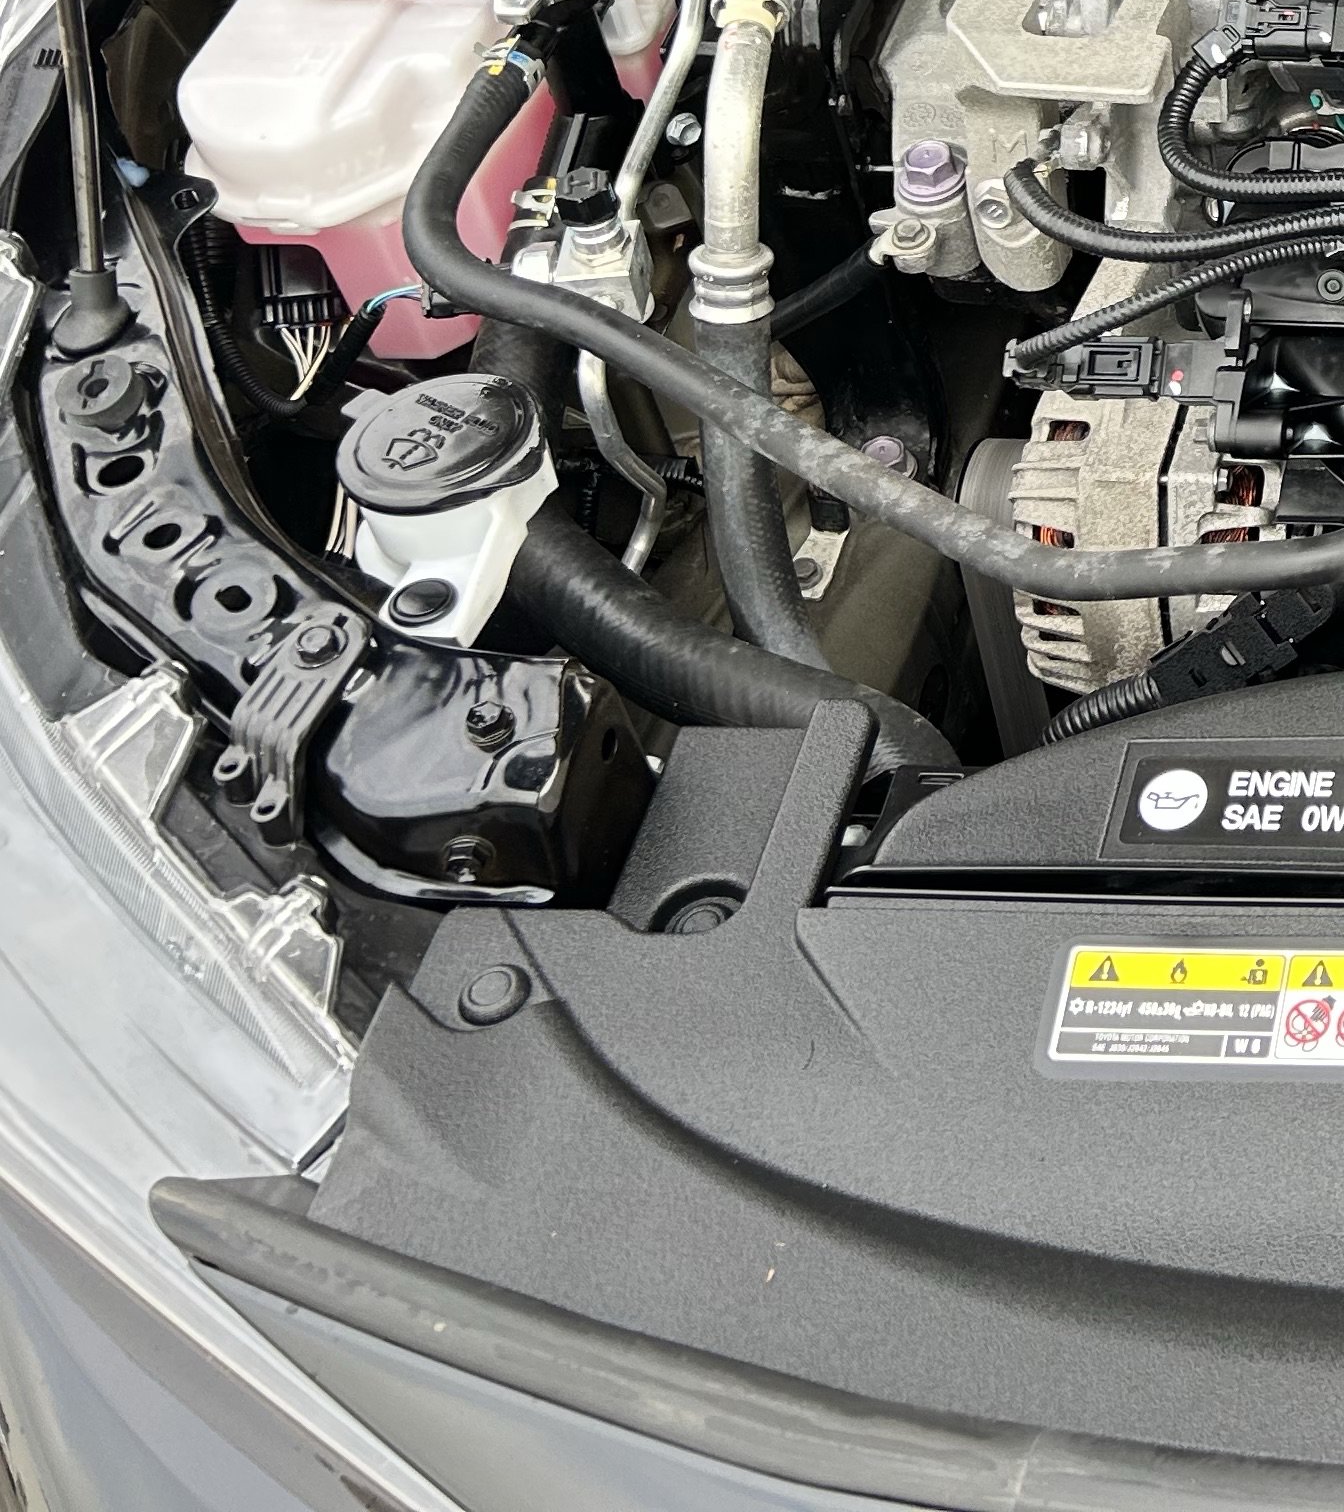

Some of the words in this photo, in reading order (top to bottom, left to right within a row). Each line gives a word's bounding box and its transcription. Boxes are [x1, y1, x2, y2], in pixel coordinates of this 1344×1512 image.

[1227, 769, 1336, 798] ENGINE
[1221, 804, 1284, 831] SAE
[1234, 1038, 1250, 1054] W
